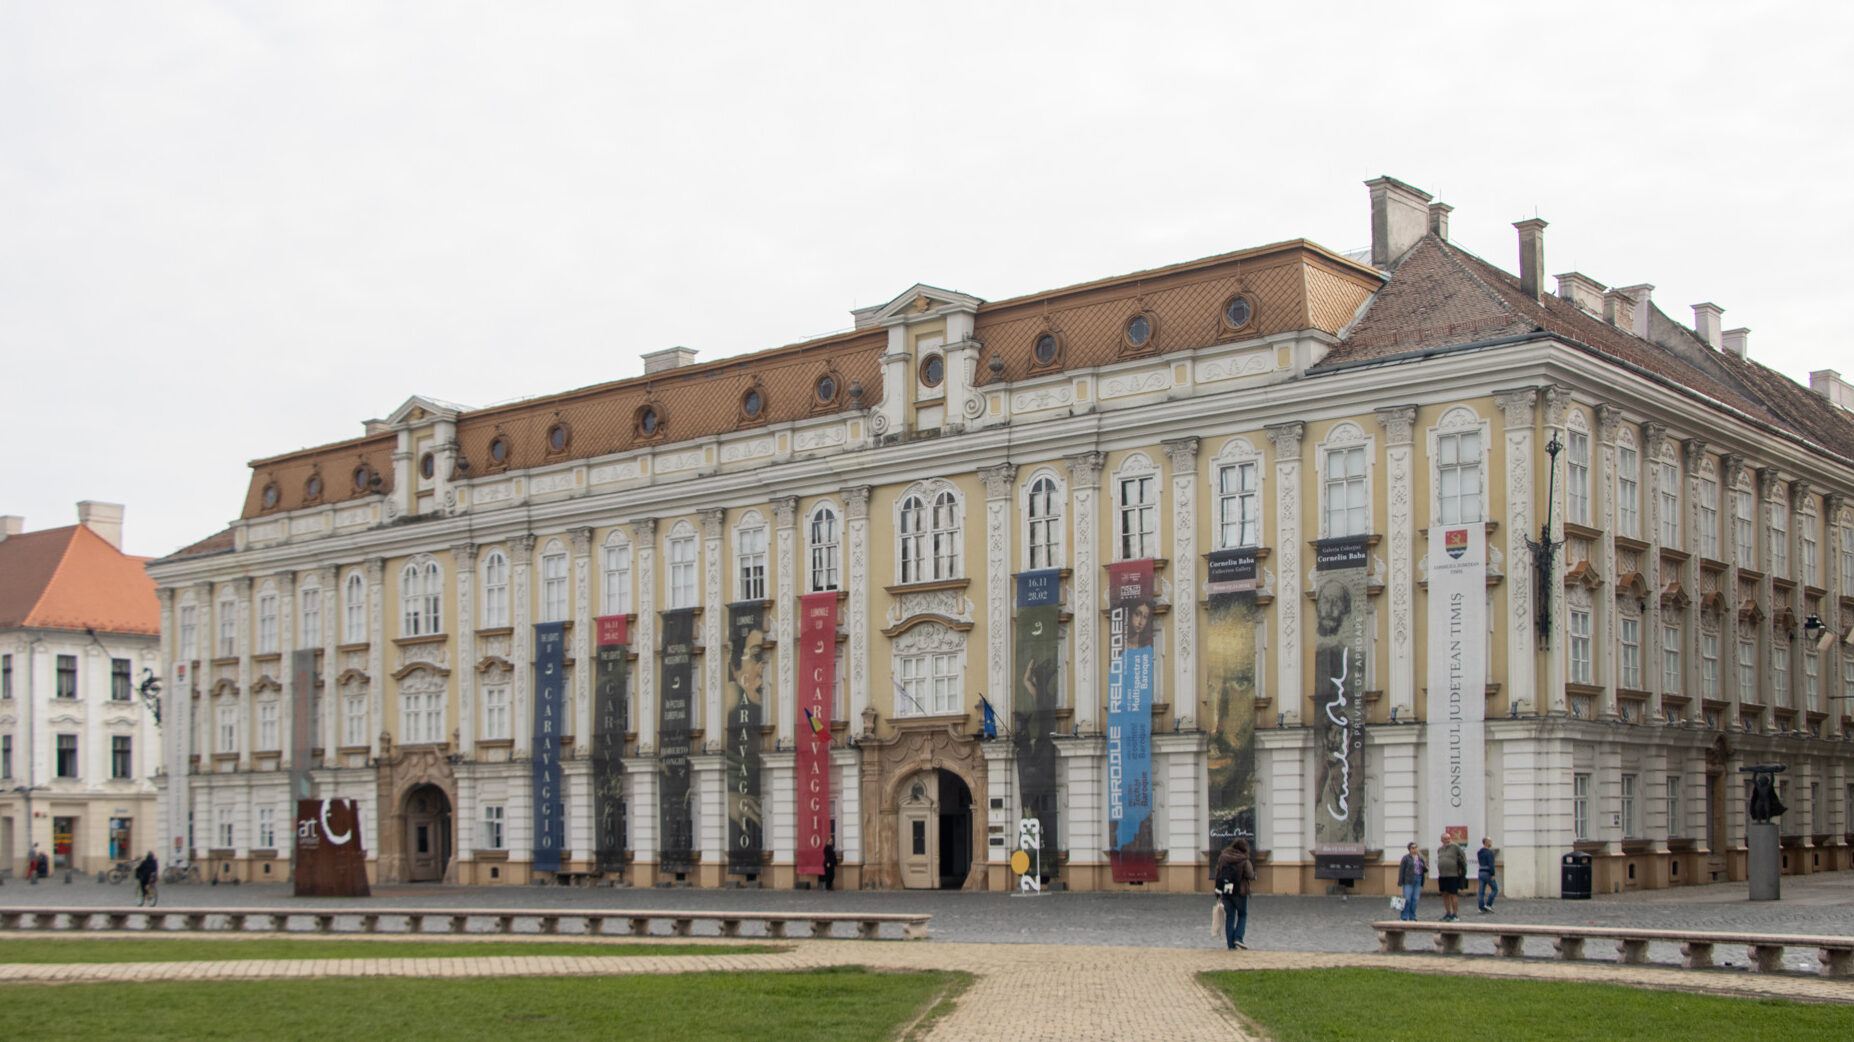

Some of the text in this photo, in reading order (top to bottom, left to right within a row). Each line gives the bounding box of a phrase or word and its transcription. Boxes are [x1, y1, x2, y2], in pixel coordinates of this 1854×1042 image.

[1209, 557, 1255, 568] Corneliu Baba
[1317, 551, 1366, 562] Corneliu Baba
[1027, 591, 1048, 600] 28.02
[1028, 577, 1047, 588] 16.11
[1354, 615, 1363, 667] APROAPE
[1140, 653, 1149, 689] Baroque
[1354, 672, 1362, 686] DE
[1109, 607, 1124, 820] BAROQUE RELOADED
[1449, 592, 1465, 808] CONSILIUL JUDEȚEAN TIMIȘ
[810, 667, 824, 849] CARVAGGIO
[1354, 741, 1362, 749] O
[542, 687, 553, 848] CARAVAGGIO
[738, 673, 751, 848] CARAVAGGIO
[298, 817, 318, 837] art
